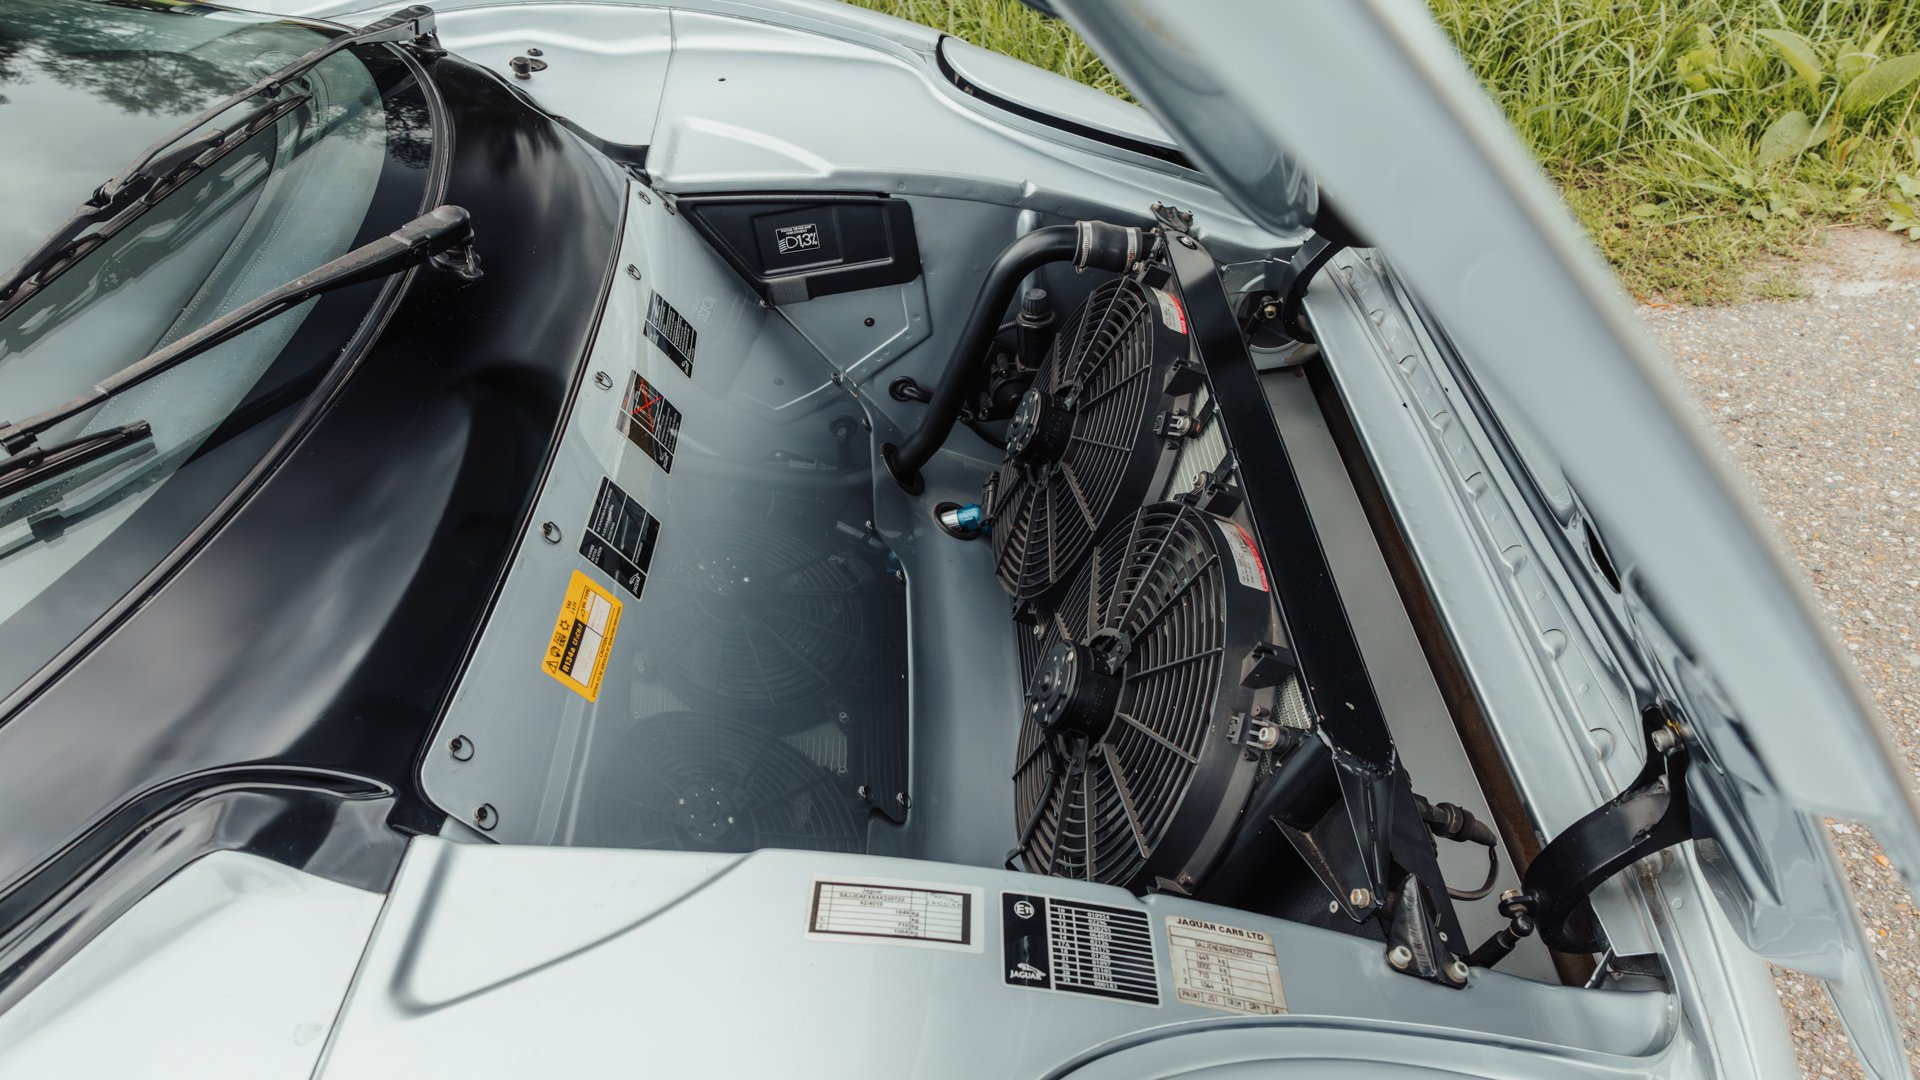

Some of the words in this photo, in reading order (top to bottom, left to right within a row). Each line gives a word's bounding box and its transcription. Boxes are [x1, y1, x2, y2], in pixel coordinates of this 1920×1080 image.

[599, 636, 608, 658] CAUTION
[562, 647, 576, 673] R134a
[1177, 918, 1216, 931] JAGUAR
[1219, 926, 1244, 937] CARS
[1247, 931, 1264, 941] LTD
[1010, 969, 1043, 981] JAGUAR
